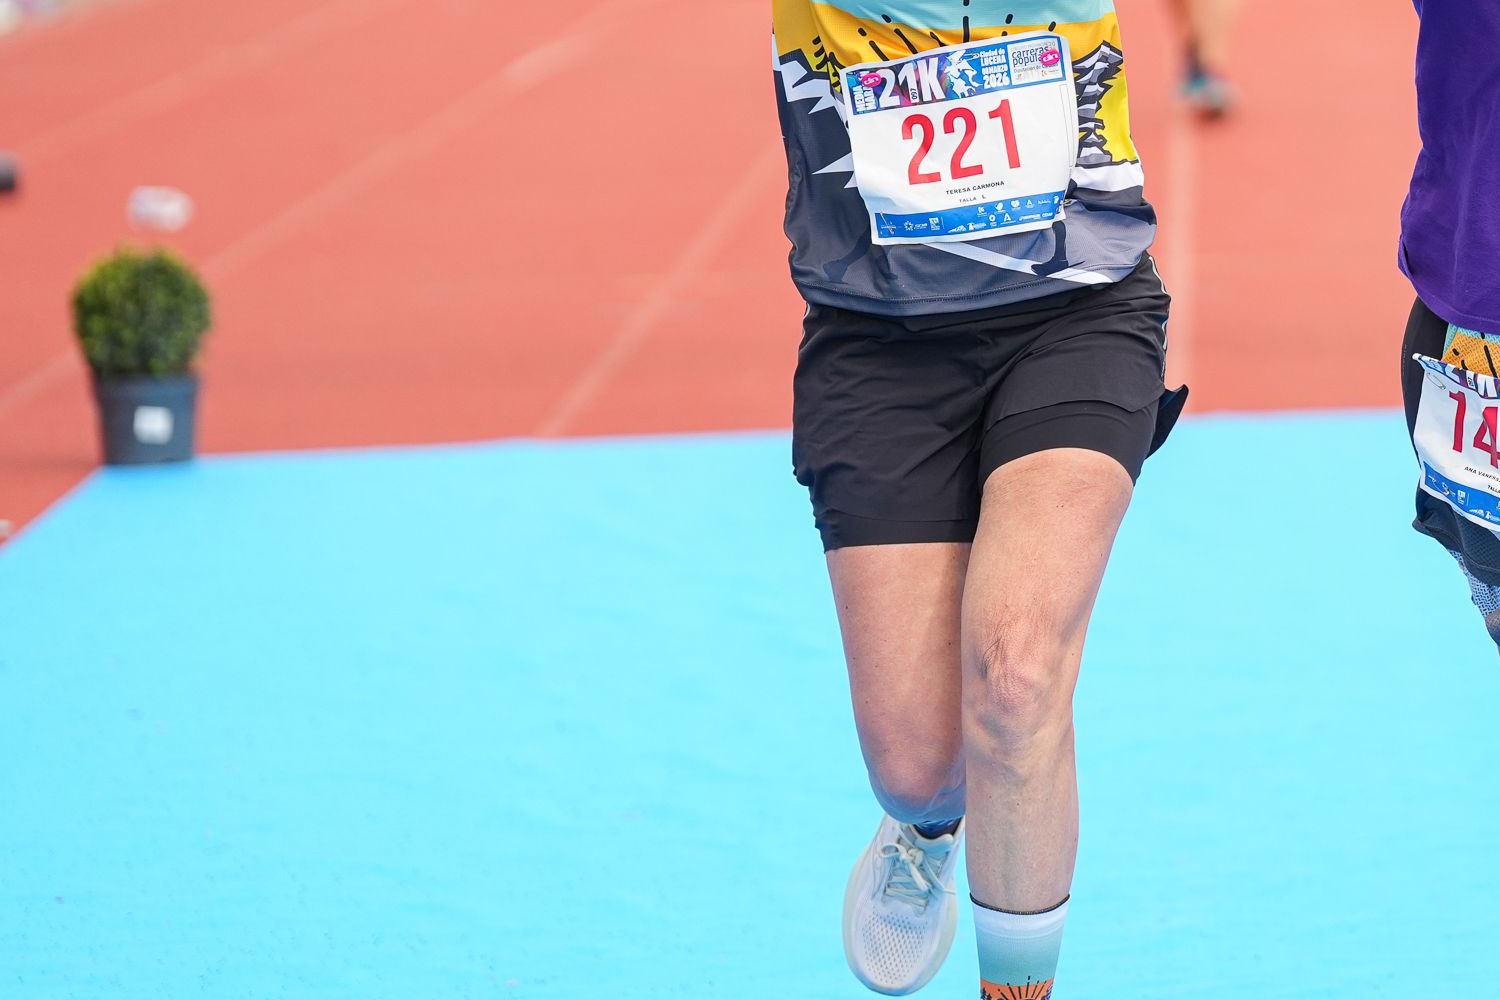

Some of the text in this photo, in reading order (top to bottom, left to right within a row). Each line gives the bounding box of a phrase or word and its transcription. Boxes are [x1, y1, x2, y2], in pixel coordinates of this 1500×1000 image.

[981, 55, 1007, 66] LUCENA
[875, 56, 946, 109] 21K
[983, 72, 1010, 89] 2026
[854, 83, 865, 113] MEDIA
[901, 98, 1021, 186] 221
[946, 180, 1005, 196] TERESA CARMONA
[1464, 466, 1476, 474] ANA
[1487, 484, 1500, 494] TALLA
